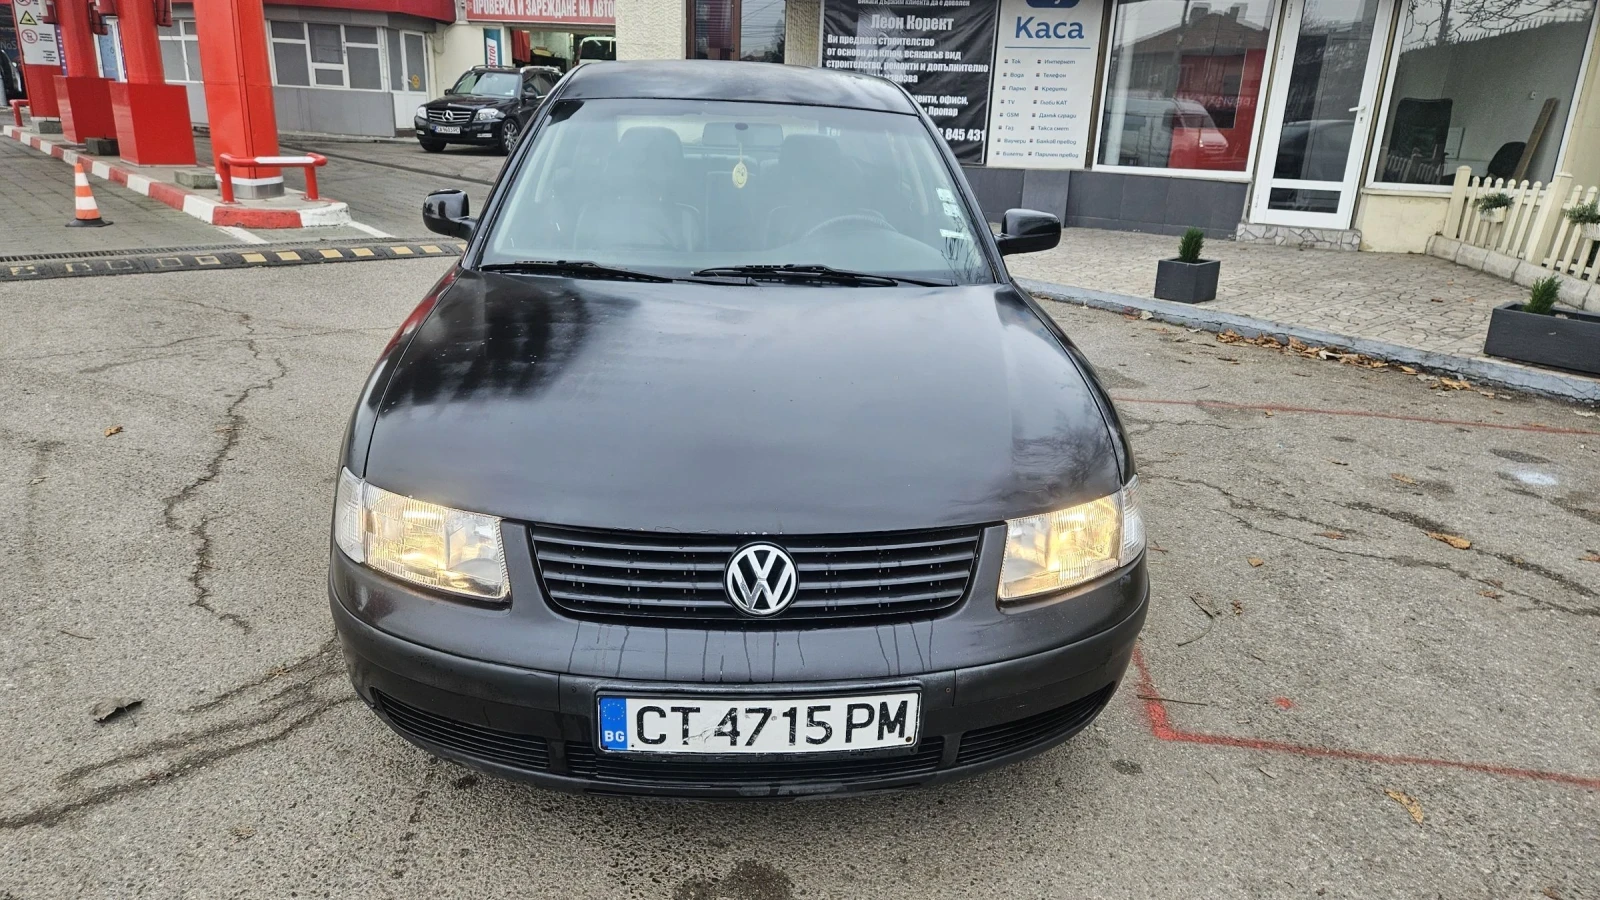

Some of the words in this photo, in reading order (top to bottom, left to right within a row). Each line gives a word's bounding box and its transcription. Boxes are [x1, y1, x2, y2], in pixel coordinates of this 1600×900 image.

[473, 0, 516, 15] ПРОВЕРКА
[518, 0, 524, 15] И
[526, 0, 577, 18] ЗАРЕЖДАНЕ
[580, 0, 591, 17] НА
[593, 0, 616, 17] АВТО
[871, 14, 904, 30] Леон
[906, 14, 954, 31] Корект
[1015, 16, 1084, 39] Каса
[827, 34, 838, 44] Ви
[840, 35, 877, 45] предлага
[878, 36, 935, 47] строителство
[827, 48, 836, 56] от
[837, 48, 865, 57] основи
[867, 49, 877, 58] до
[904, 50, 943, 59] всякакъв
[945, 51, 962, 60] вид
[826, 60, 883, 70] строителство,
[884, 62, 919, 71] ремонти
[920, 62, 926, 71] и
[927, 63, 989, 73] допълнително
[940, 95, 969, 105] офиси,
[928, 106, 959, 117] Пропар
[945, 128, 966, 141] 845
[967, 128, 985, 141] 431
[636, 705, 701, 745] CT
[714, 704, 833, 747] 4715
[845, 700, 908, 744] PM
[604, 730, 625, 742] BG
